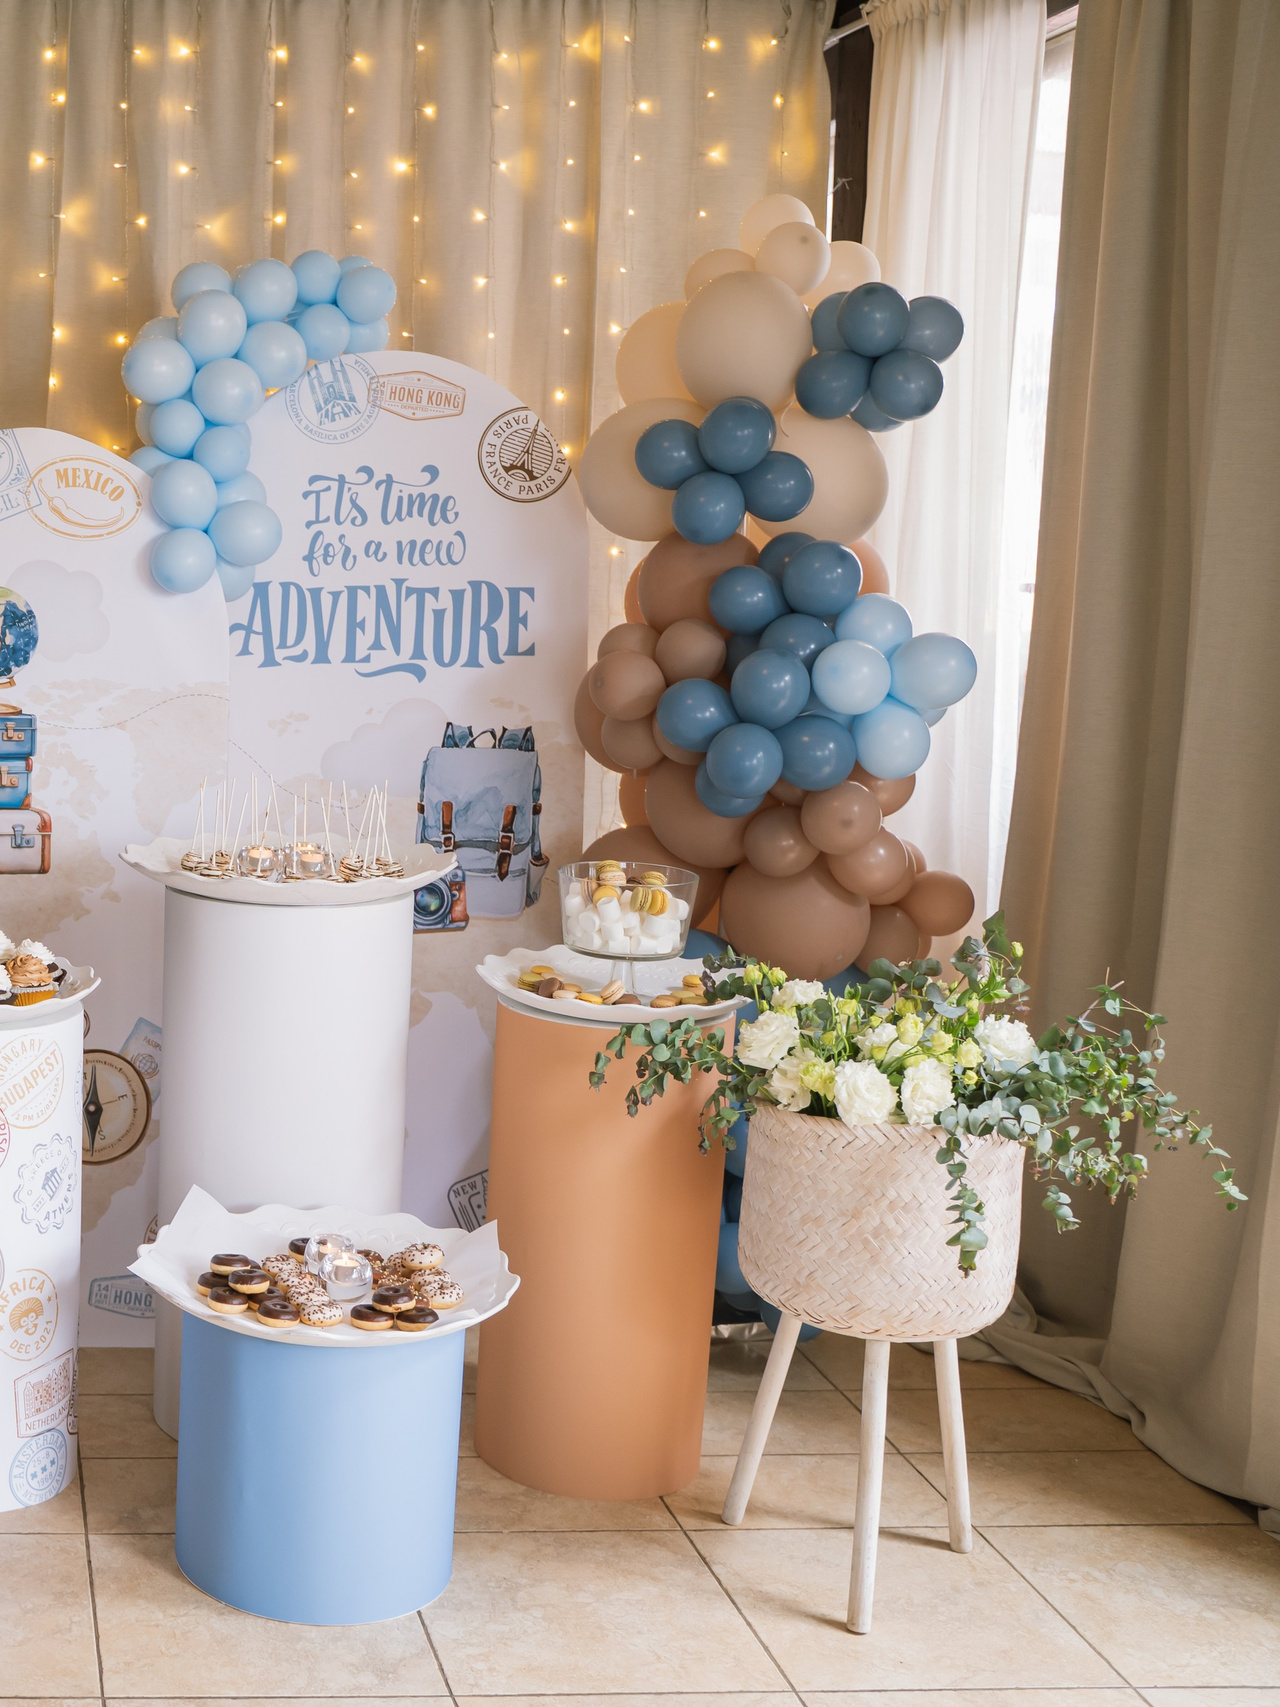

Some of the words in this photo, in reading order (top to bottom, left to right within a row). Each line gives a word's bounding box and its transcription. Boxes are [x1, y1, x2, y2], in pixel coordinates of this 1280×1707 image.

[389, 385, 423, 404] HONG
[426, 390, 461, 409] KONG
[400, 404, 429, 413] DEPARTED
[339, 431, 350, 440] OF
[492, 414, 529, 439] PARIS
[485, 442, 513, 491] FRANCE
[518, 475, 556, 495] PARIS
[55, 467, 125, 502] MEXICO
[302, 465, 375, 529] It's
[375, 465, 460, 527] time
[302, 530, 357, 578] for
[363, 539, 387, 562] a
[395, 530, 467, 567] new
[229, 578, 535, 670] ADVENTURE
[97, 1129, 106, 1141] S
[43, 1172, 73, 1222] ATHENS
[452, 1180, 478, 1199] NEW
[96, 1283, 109, 1293] 14
[113, 1289, 153, 1308] HONG
[9, 1338, 31, 1354] DEC
[34, 1320, 53, 1351] 2021
[13, 1433, 65, 1479] AMSTERDAM
